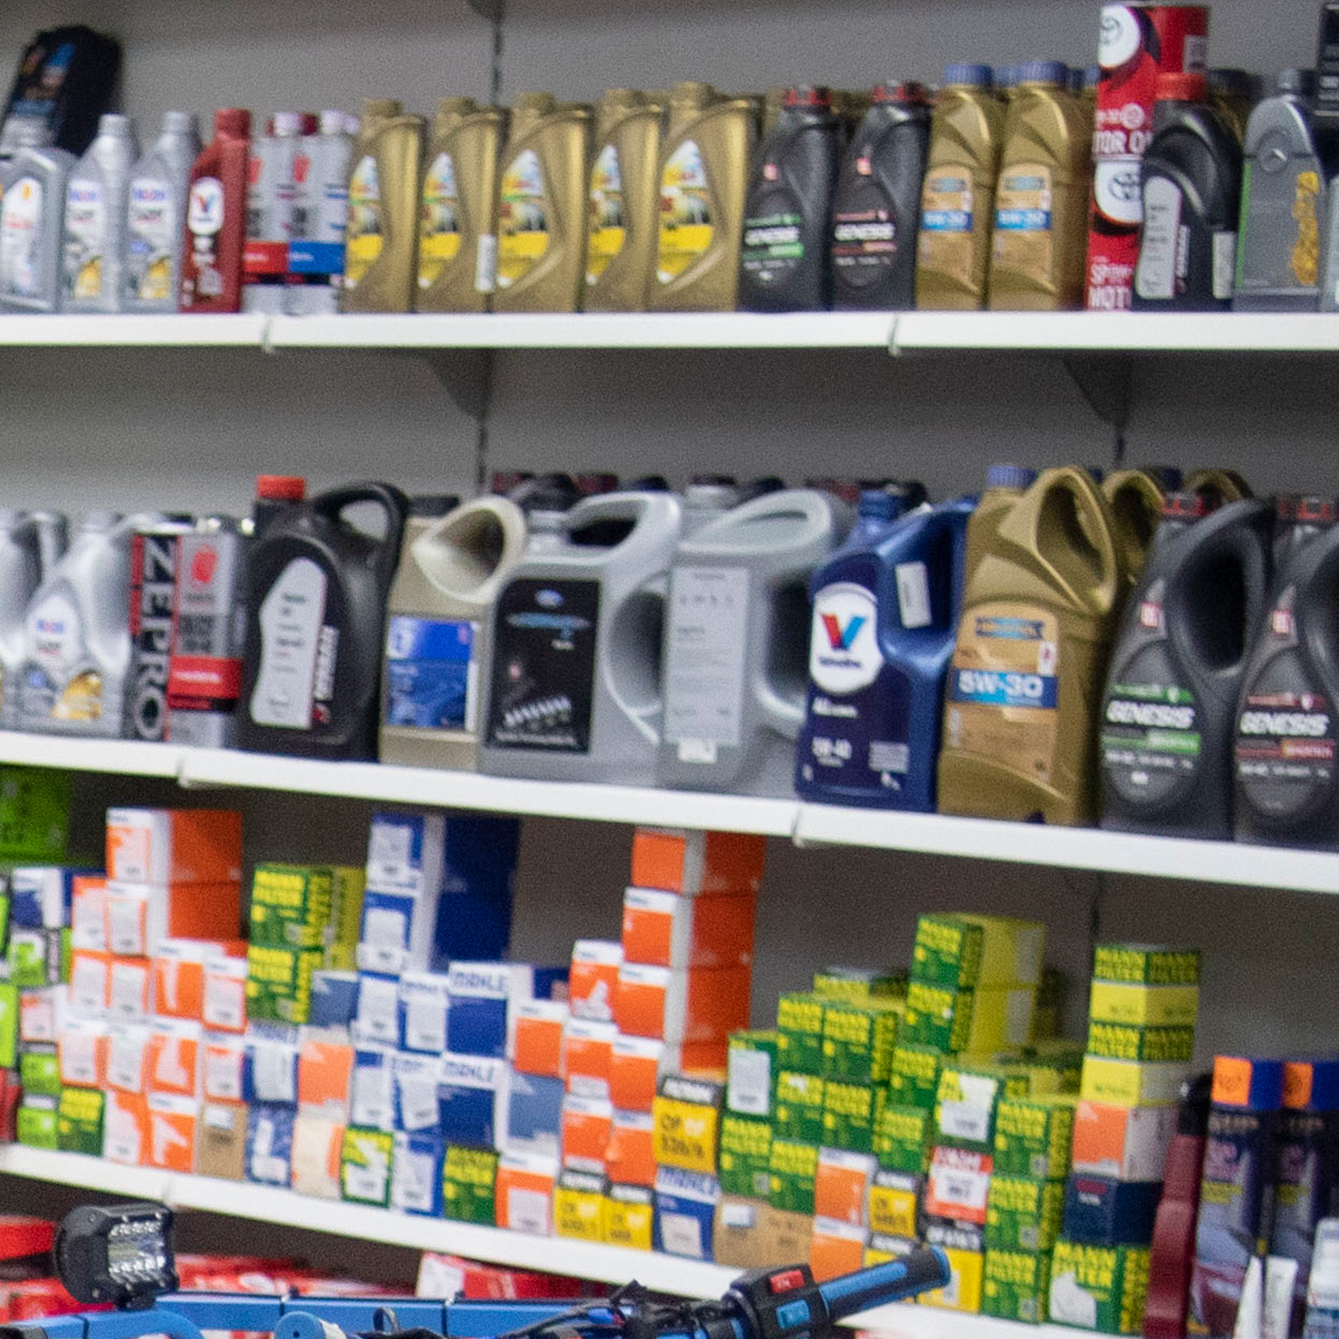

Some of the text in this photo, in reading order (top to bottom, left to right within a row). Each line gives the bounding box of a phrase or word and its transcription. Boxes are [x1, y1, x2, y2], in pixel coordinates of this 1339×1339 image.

[133, 537, 174, 740] ZEPRO
[958, 669, 1044, 697] 5W-30
[1106, 700, 1196, 729] GENESIS
[1240, 711, 1330, 736] GENESIS
[1054, 1241, 1116, 1268] MANN
